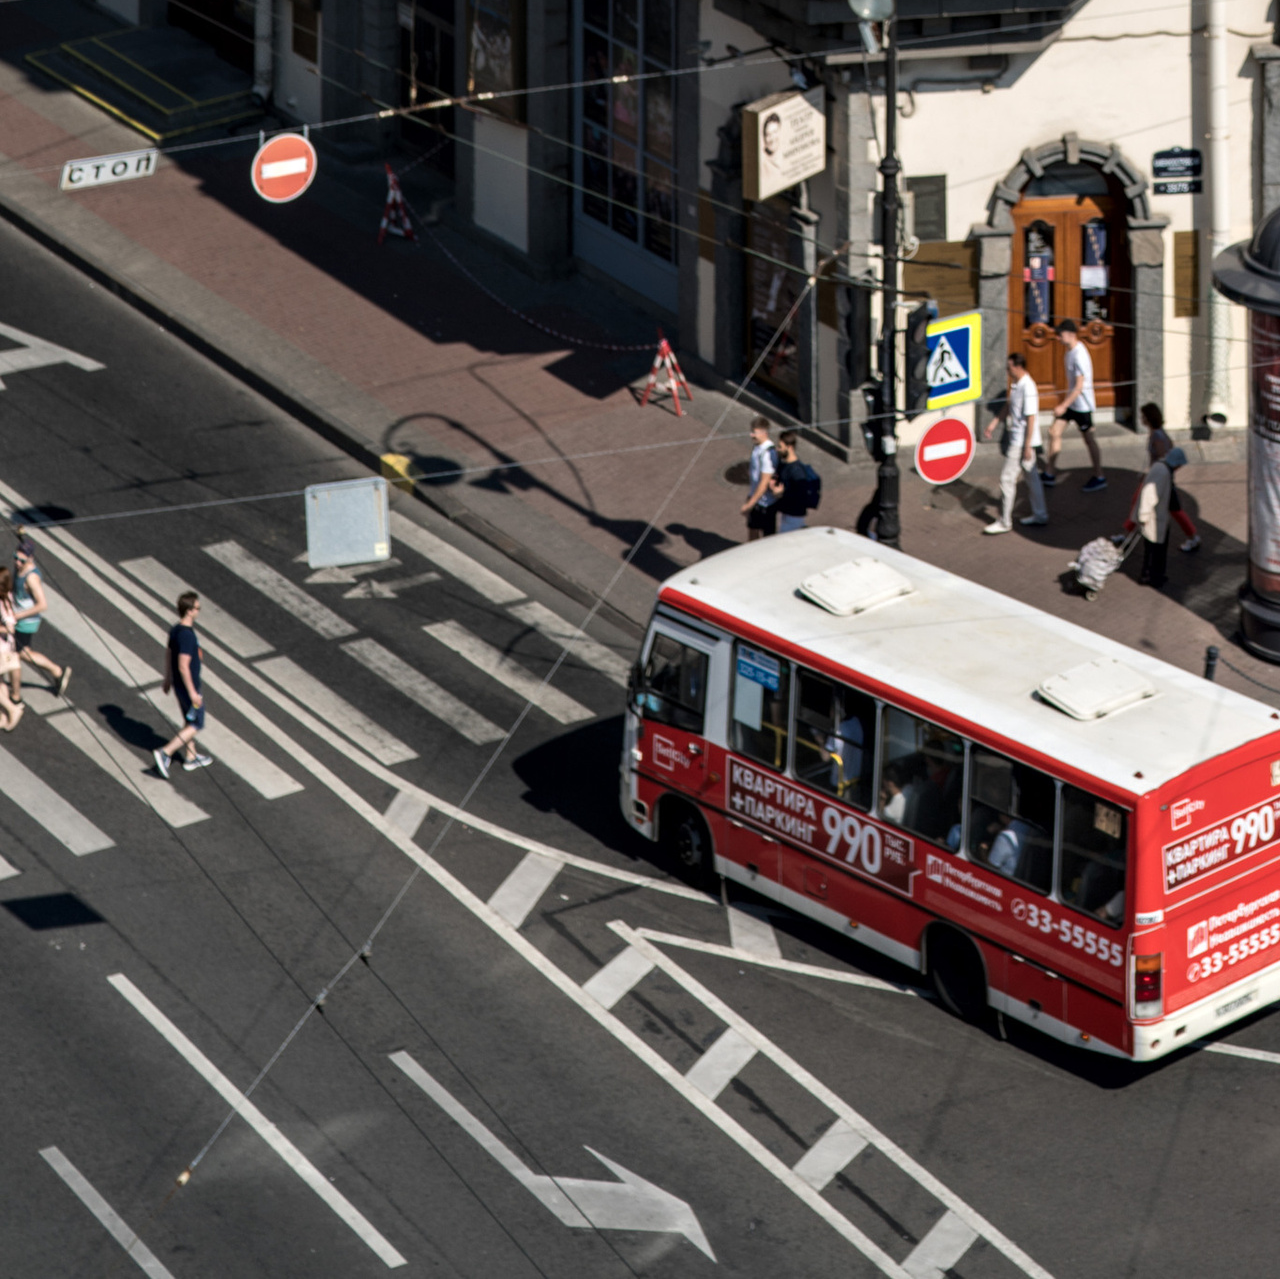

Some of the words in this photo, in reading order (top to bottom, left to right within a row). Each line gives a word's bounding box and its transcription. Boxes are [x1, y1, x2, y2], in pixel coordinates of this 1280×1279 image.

[67, 152, 151, 185] СТОП
[732, 791, 818, 844] +ПАРКИНГ
[733, 763, 817, 821] КВАРТИРА
[822, 807, 882, 874] 990
[1166, 826, 1230, 866] КВАРТИРА
[1231, 805, 1275, 854] 990
[1166, 843, 1231, 885] +ПАРКИНГ
[1026, 903, 1124, 967] 33-55555
